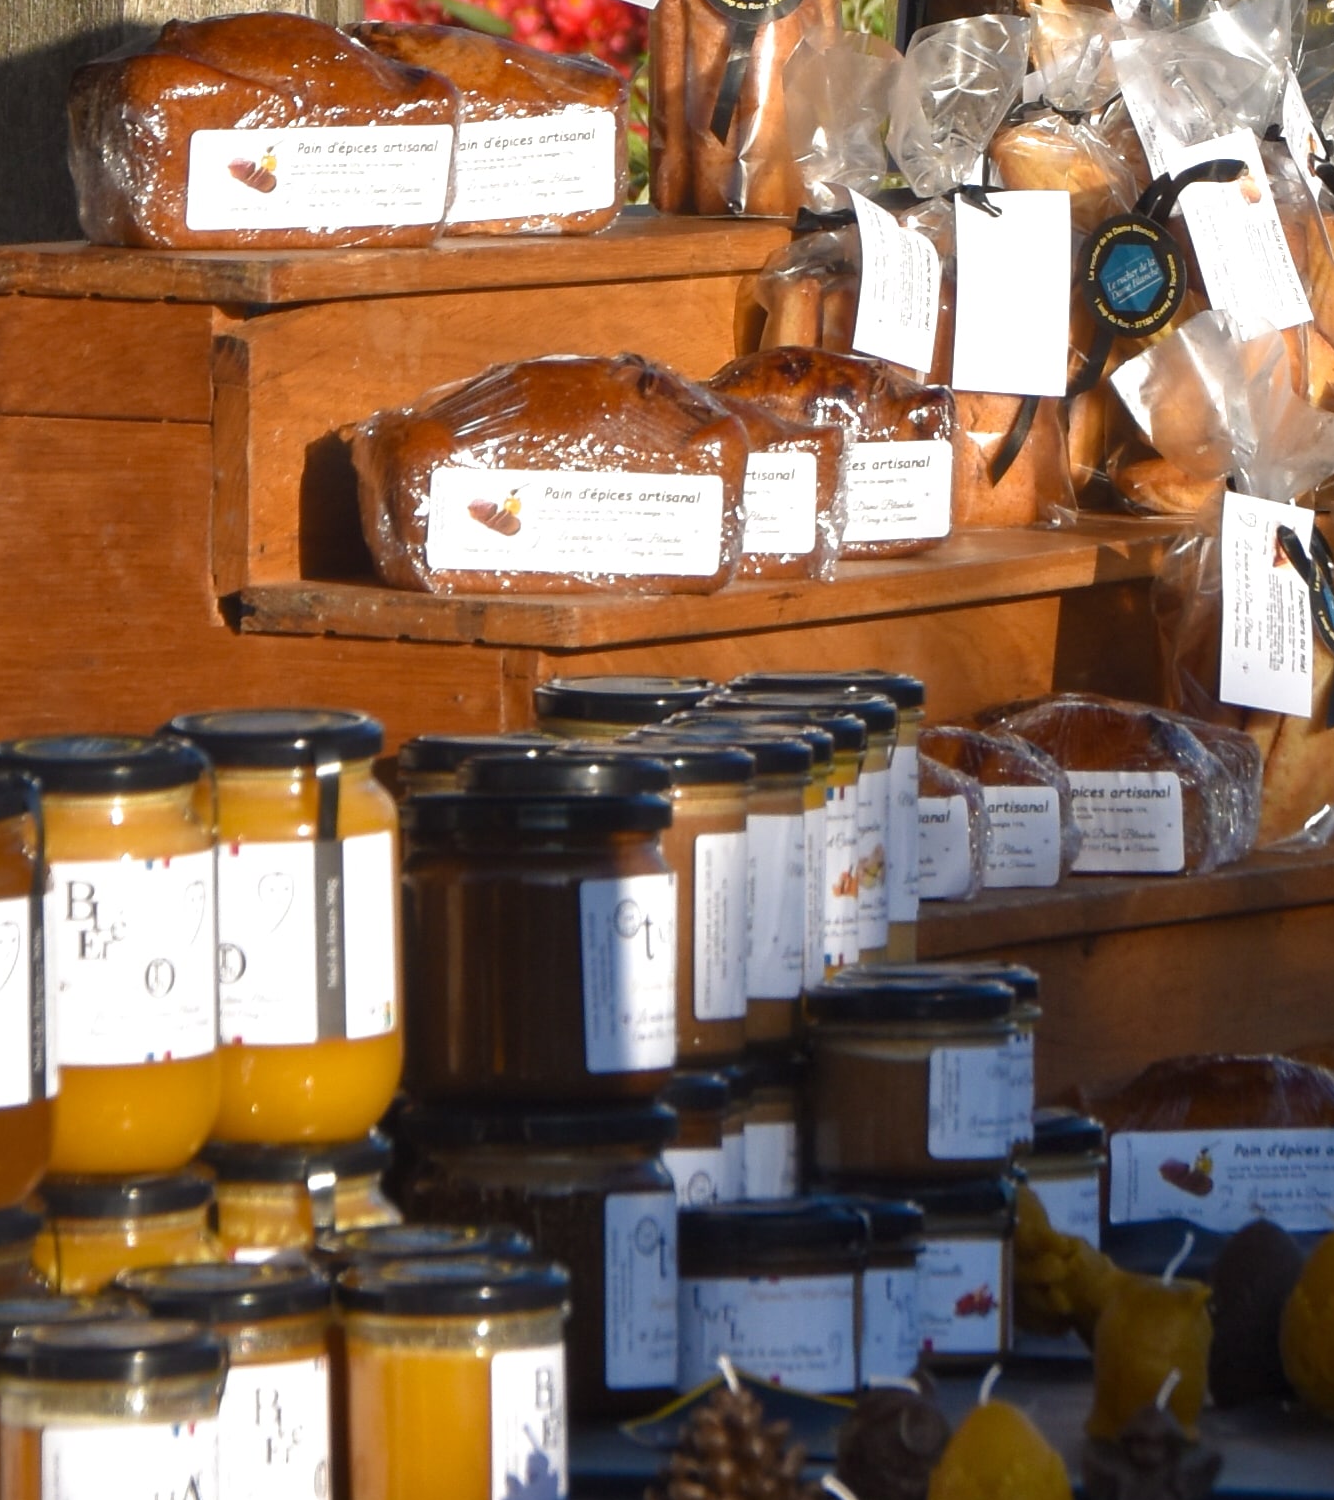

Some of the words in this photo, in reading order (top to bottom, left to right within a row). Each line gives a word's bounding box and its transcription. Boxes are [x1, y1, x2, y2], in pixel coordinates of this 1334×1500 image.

[297, 142, 322, 155] Pain
[383, 139, 439, 153] artisanal
[459, 138, 478, 152] ain
[538, 128, 597, 146] artisanal
[871, 456, 932, 471] artisanal
[745, 468, 797, 482] tisanal
[544, 486, 573, 501] Pain
[639, 490, 702, 505] artisanal
[1299, 653, 1308, 674] miel
[1071, 785, 1105, 800] pices
[1109, 784, 1172, 801] artisanal
[986, 799, 1050, 814] artisanal
[1233, 1142, 1262, 1158] Pain
